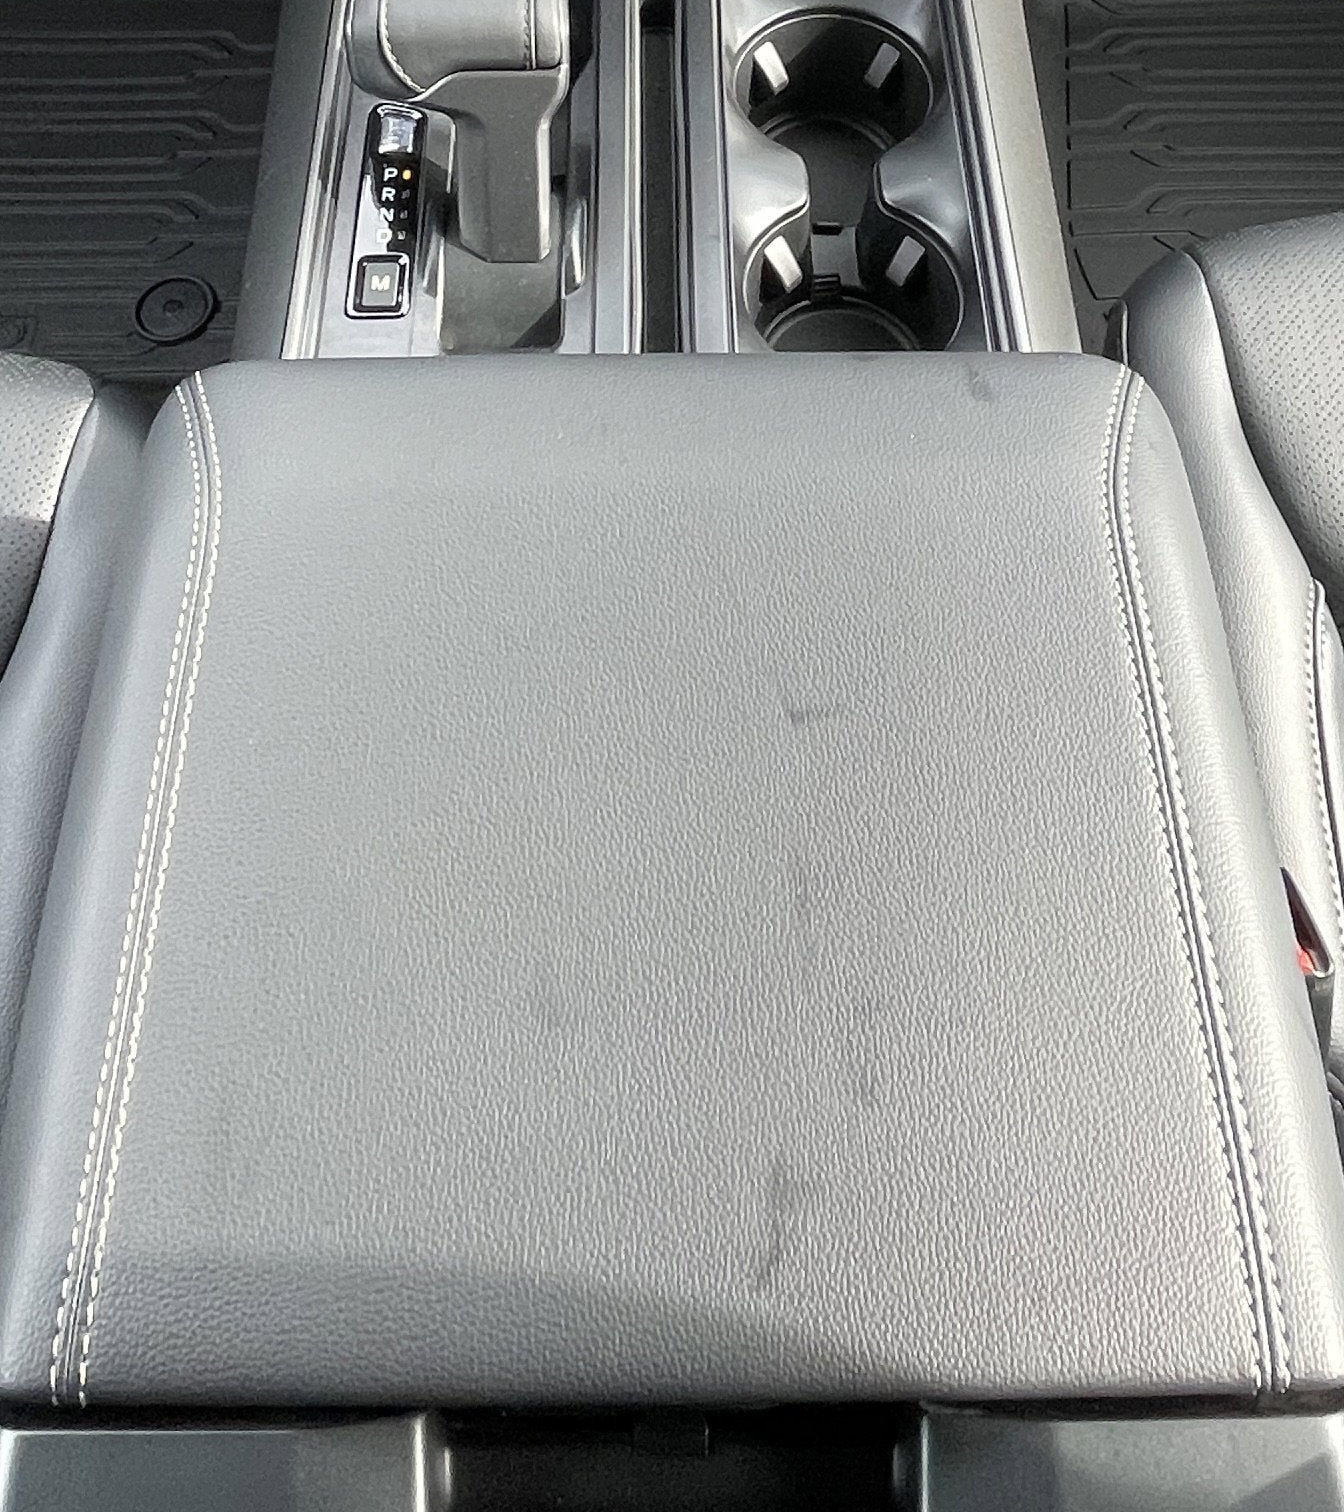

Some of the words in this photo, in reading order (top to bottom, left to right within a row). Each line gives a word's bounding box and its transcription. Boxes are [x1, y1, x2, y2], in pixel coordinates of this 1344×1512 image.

[383, 167, 399, 182] P
[380, 186, 396, 202] R
[378, 207, 394, 222] N
[375, 228, 393, 243] D
[370, 275, 391, 292] M
